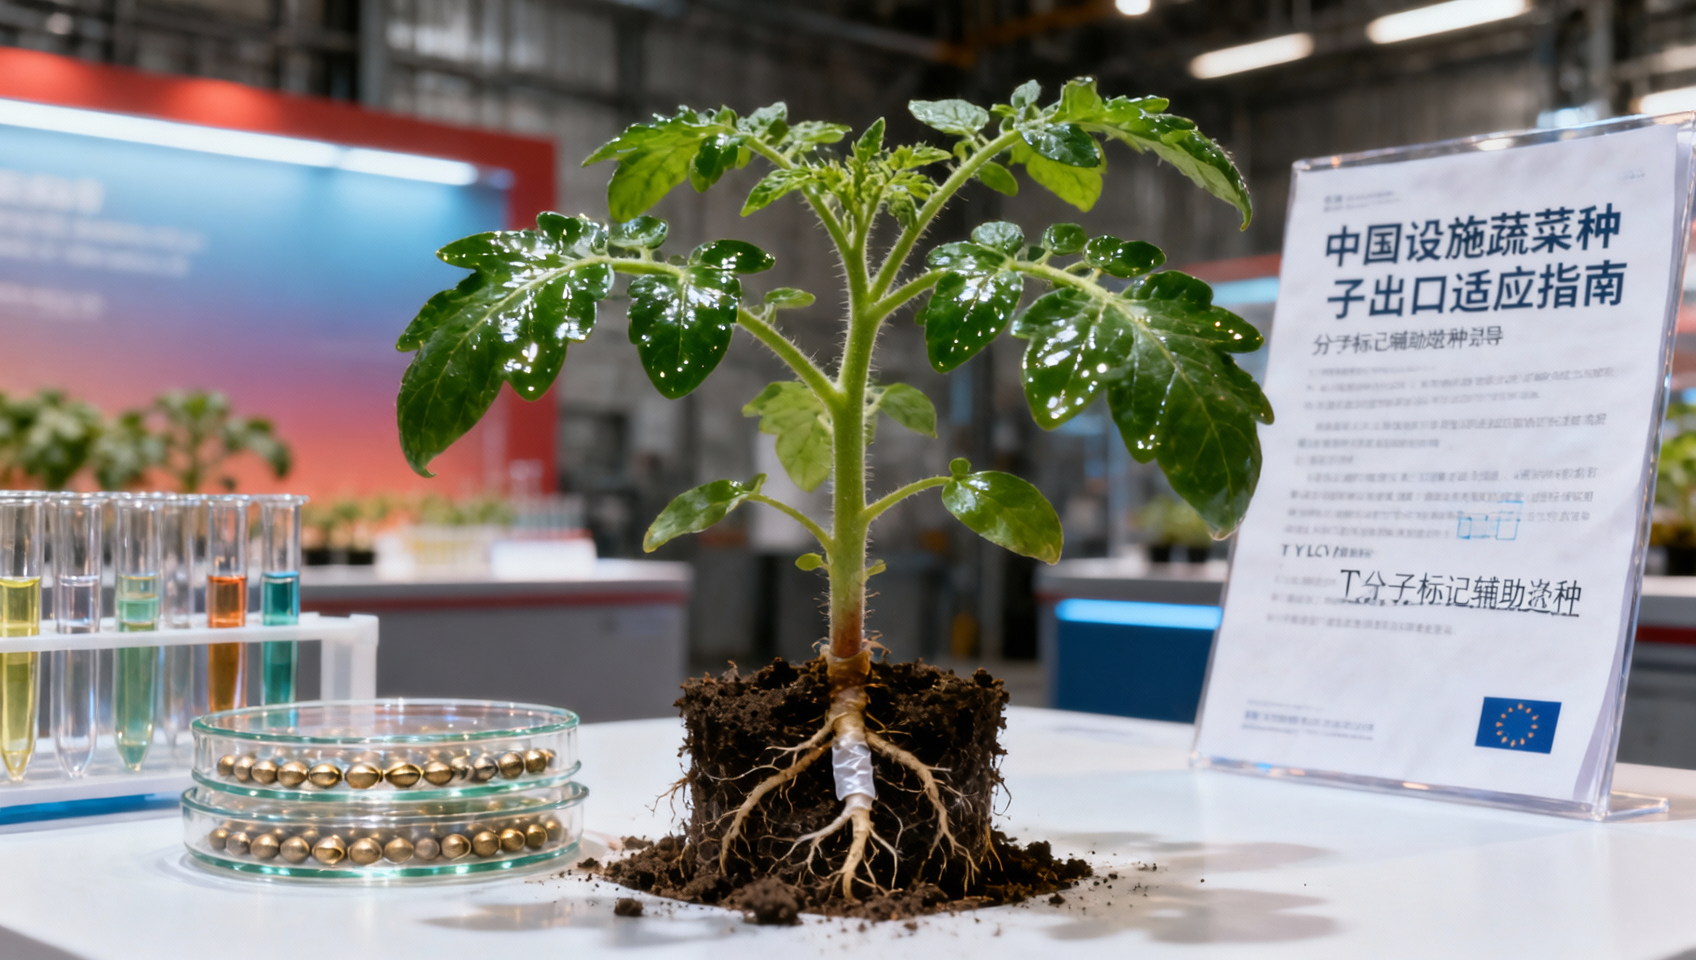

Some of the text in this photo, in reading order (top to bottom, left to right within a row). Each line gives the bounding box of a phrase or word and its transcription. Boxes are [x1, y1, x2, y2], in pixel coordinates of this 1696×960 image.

[1325, 203, 1621, 267] 中国设施蔬菜种
[1327, 260, 1627, 319] 子出口适应指南
